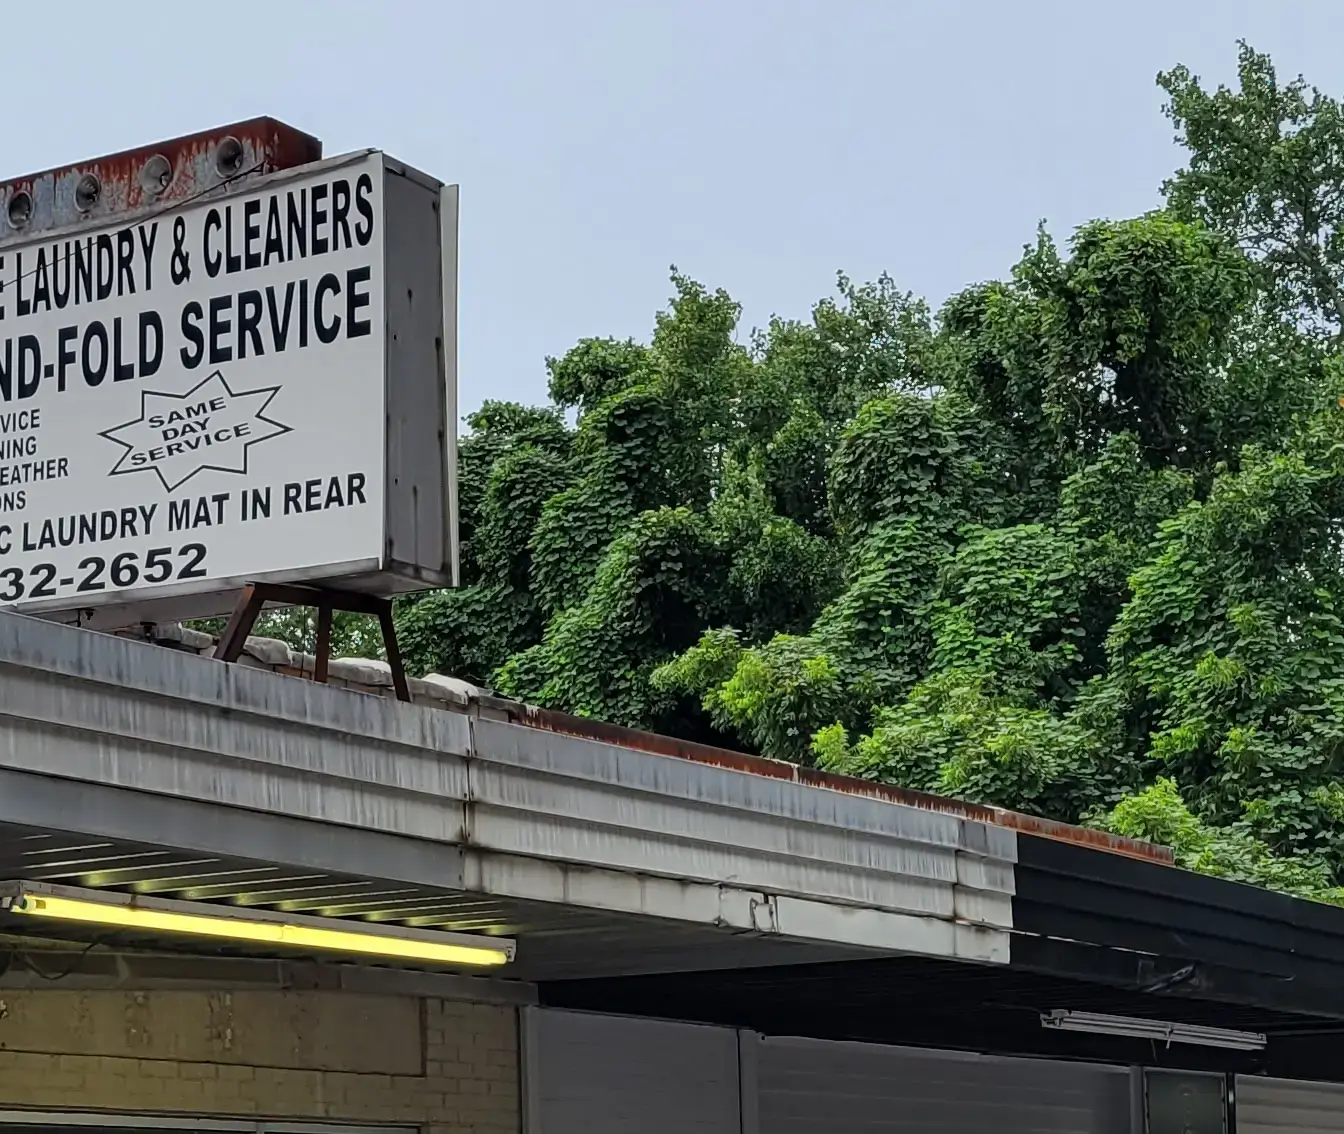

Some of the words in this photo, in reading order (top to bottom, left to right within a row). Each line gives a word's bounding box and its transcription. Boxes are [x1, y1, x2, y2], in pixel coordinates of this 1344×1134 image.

[16, 222, 159, 317] LAUNDRY
[170, 216, 192, 286] &
[203, 173, 374, 278] CLEANERS
[179, 265, 372, 370] SERVICE
[148, 396, 227, 429] SAME
[161, 417, 211, 442] DAY
[130, 422, 252, 466] SERVICE
[22, 503, 158, 552] LAUNDRY
[168, 493, 230, 532] MAT
[241, 487, 271, 521] IN
[283, 472, 367, 515] REAR
